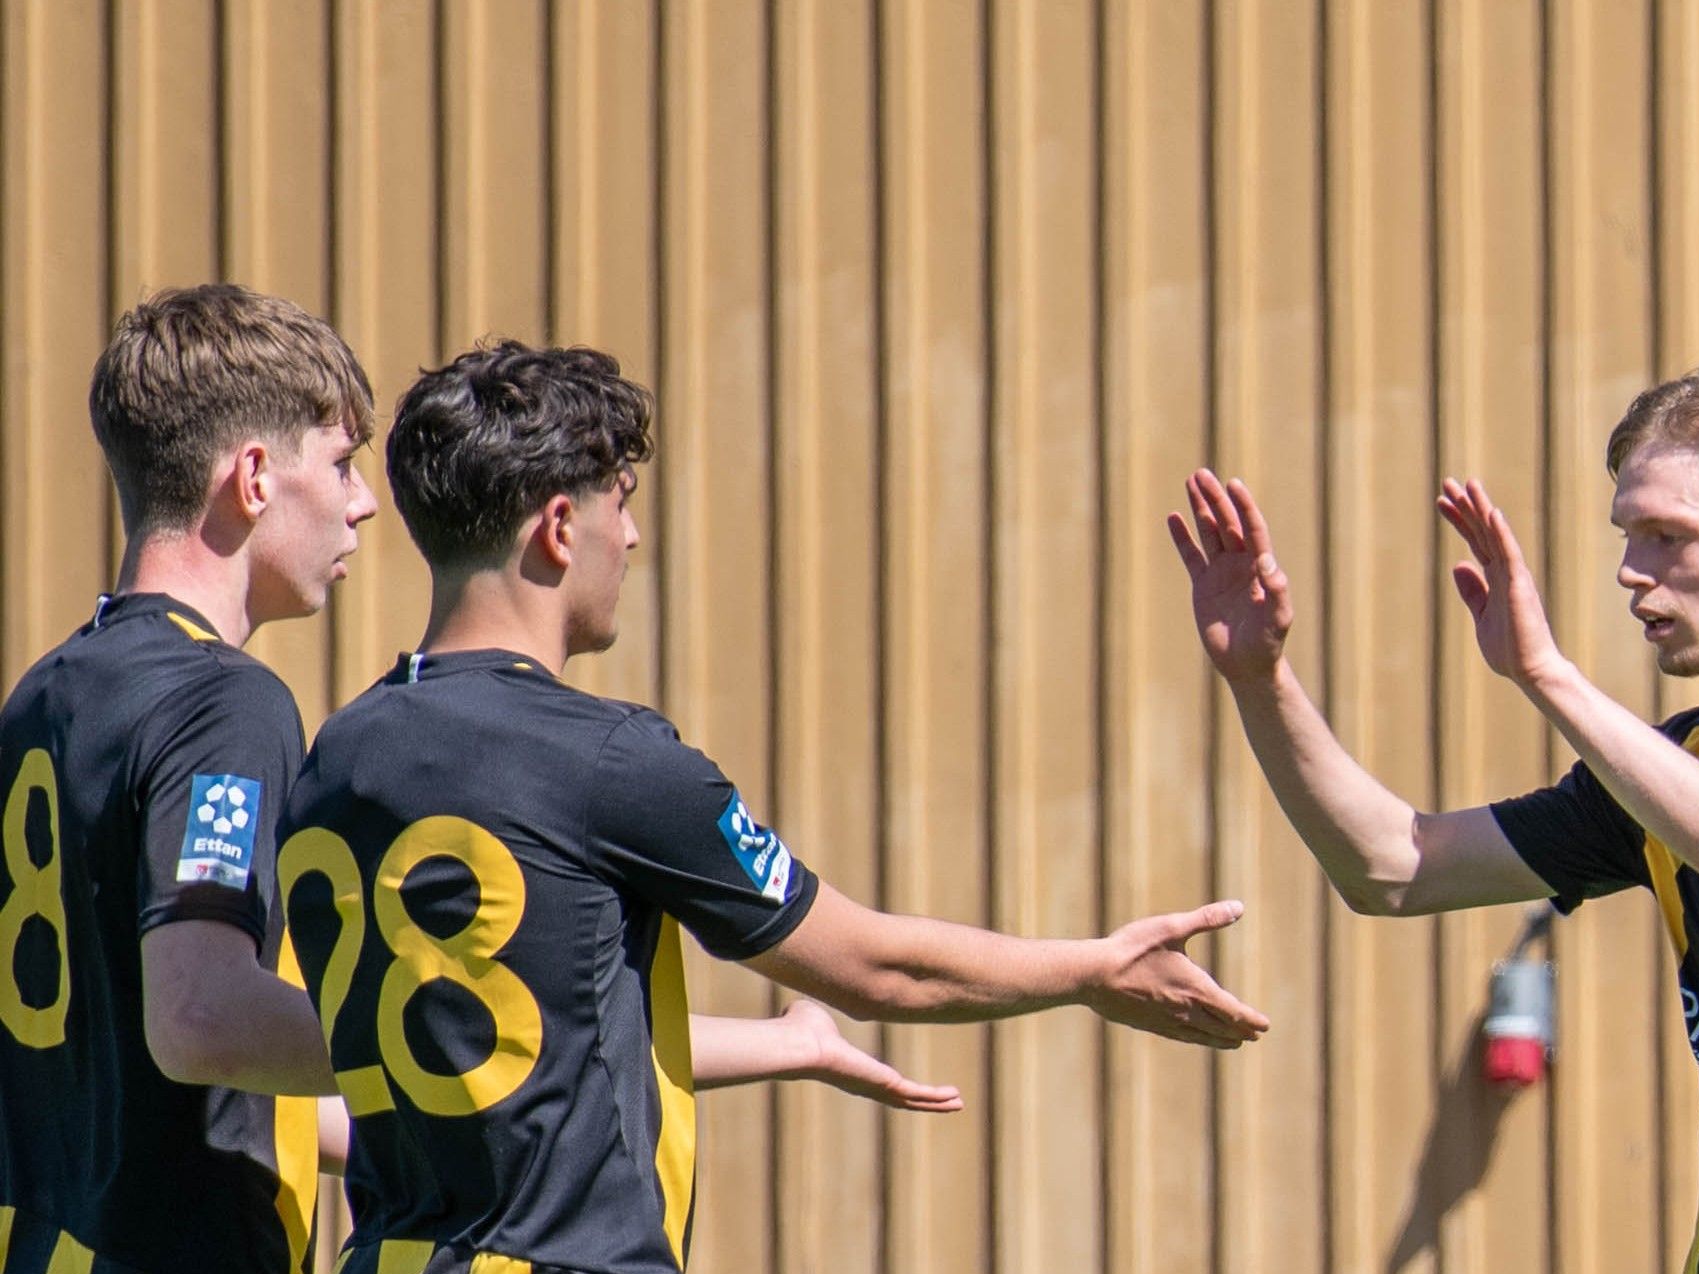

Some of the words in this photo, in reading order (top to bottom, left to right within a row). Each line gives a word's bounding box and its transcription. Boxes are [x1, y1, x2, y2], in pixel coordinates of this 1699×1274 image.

[0, 748, 71, 1049] 8
[193, 838, 242, 859] Ettan
[277, 814, 543, 1117] 28
